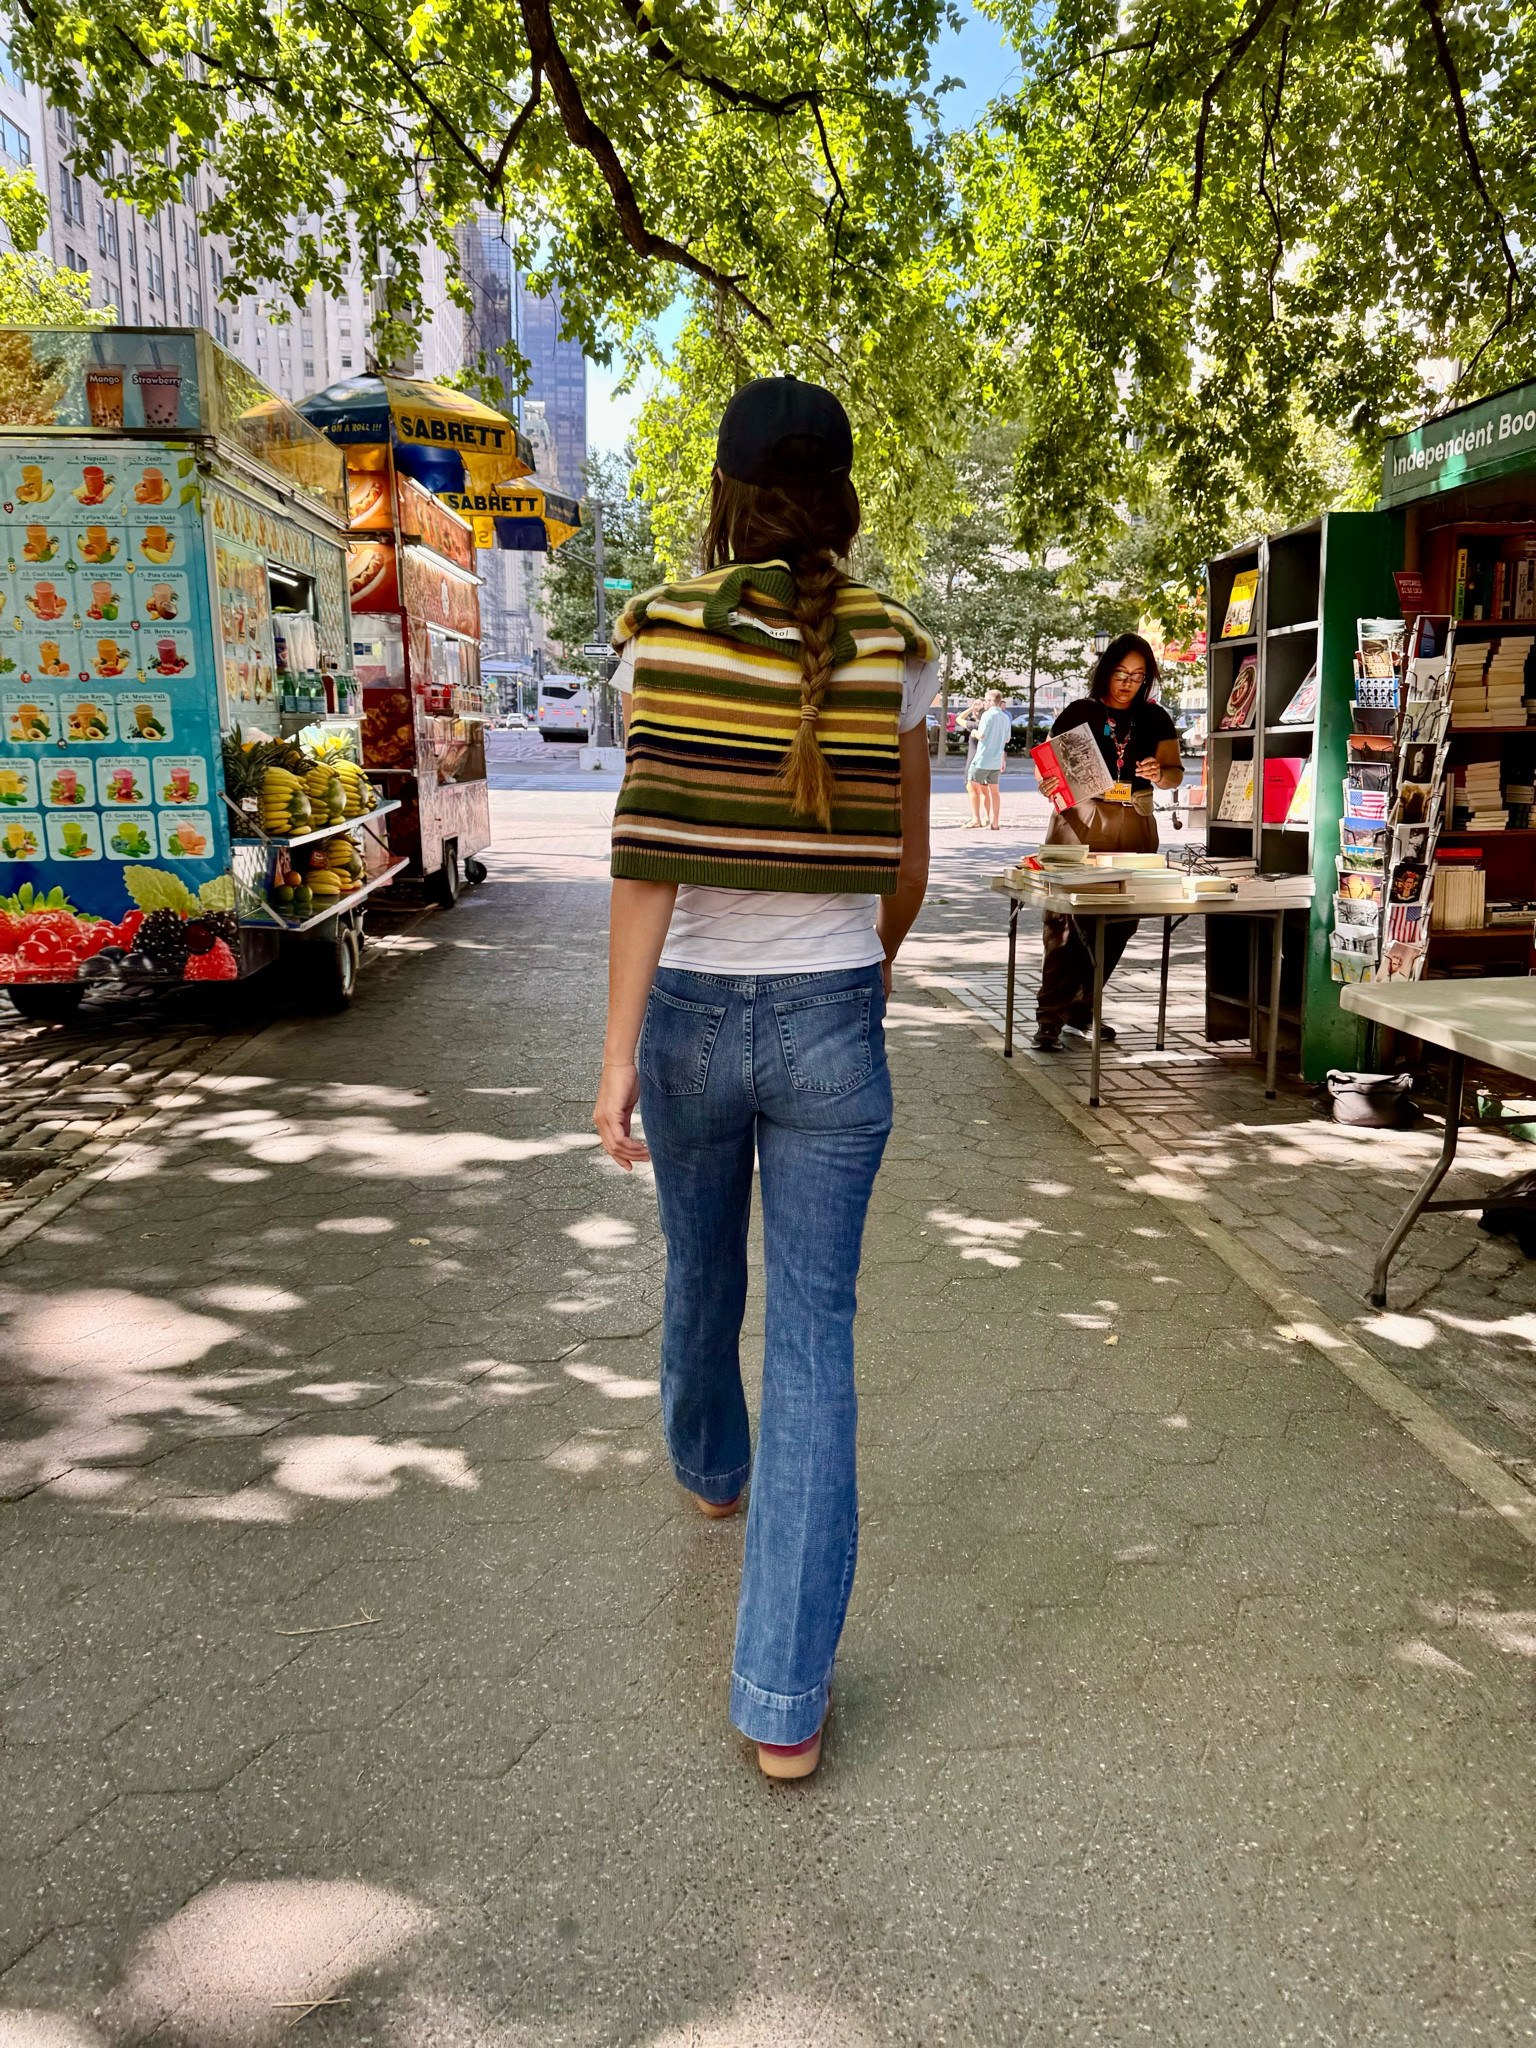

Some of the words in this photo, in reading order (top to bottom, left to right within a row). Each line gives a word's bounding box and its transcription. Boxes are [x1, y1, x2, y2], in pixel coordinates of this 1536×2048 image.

[89, 374, 120, 385] Mango
[132, 374, 182, 387] Strawberry
[331, 424, 342, 432] ON
[344, 424, 350, 432] A
[352, 423, 370, 432] ROLL
[400, 415, 506, 449] SABRETT
[1393, 420, 1494, 477] Independent
[448, 494, 539, 512] SABRETT
